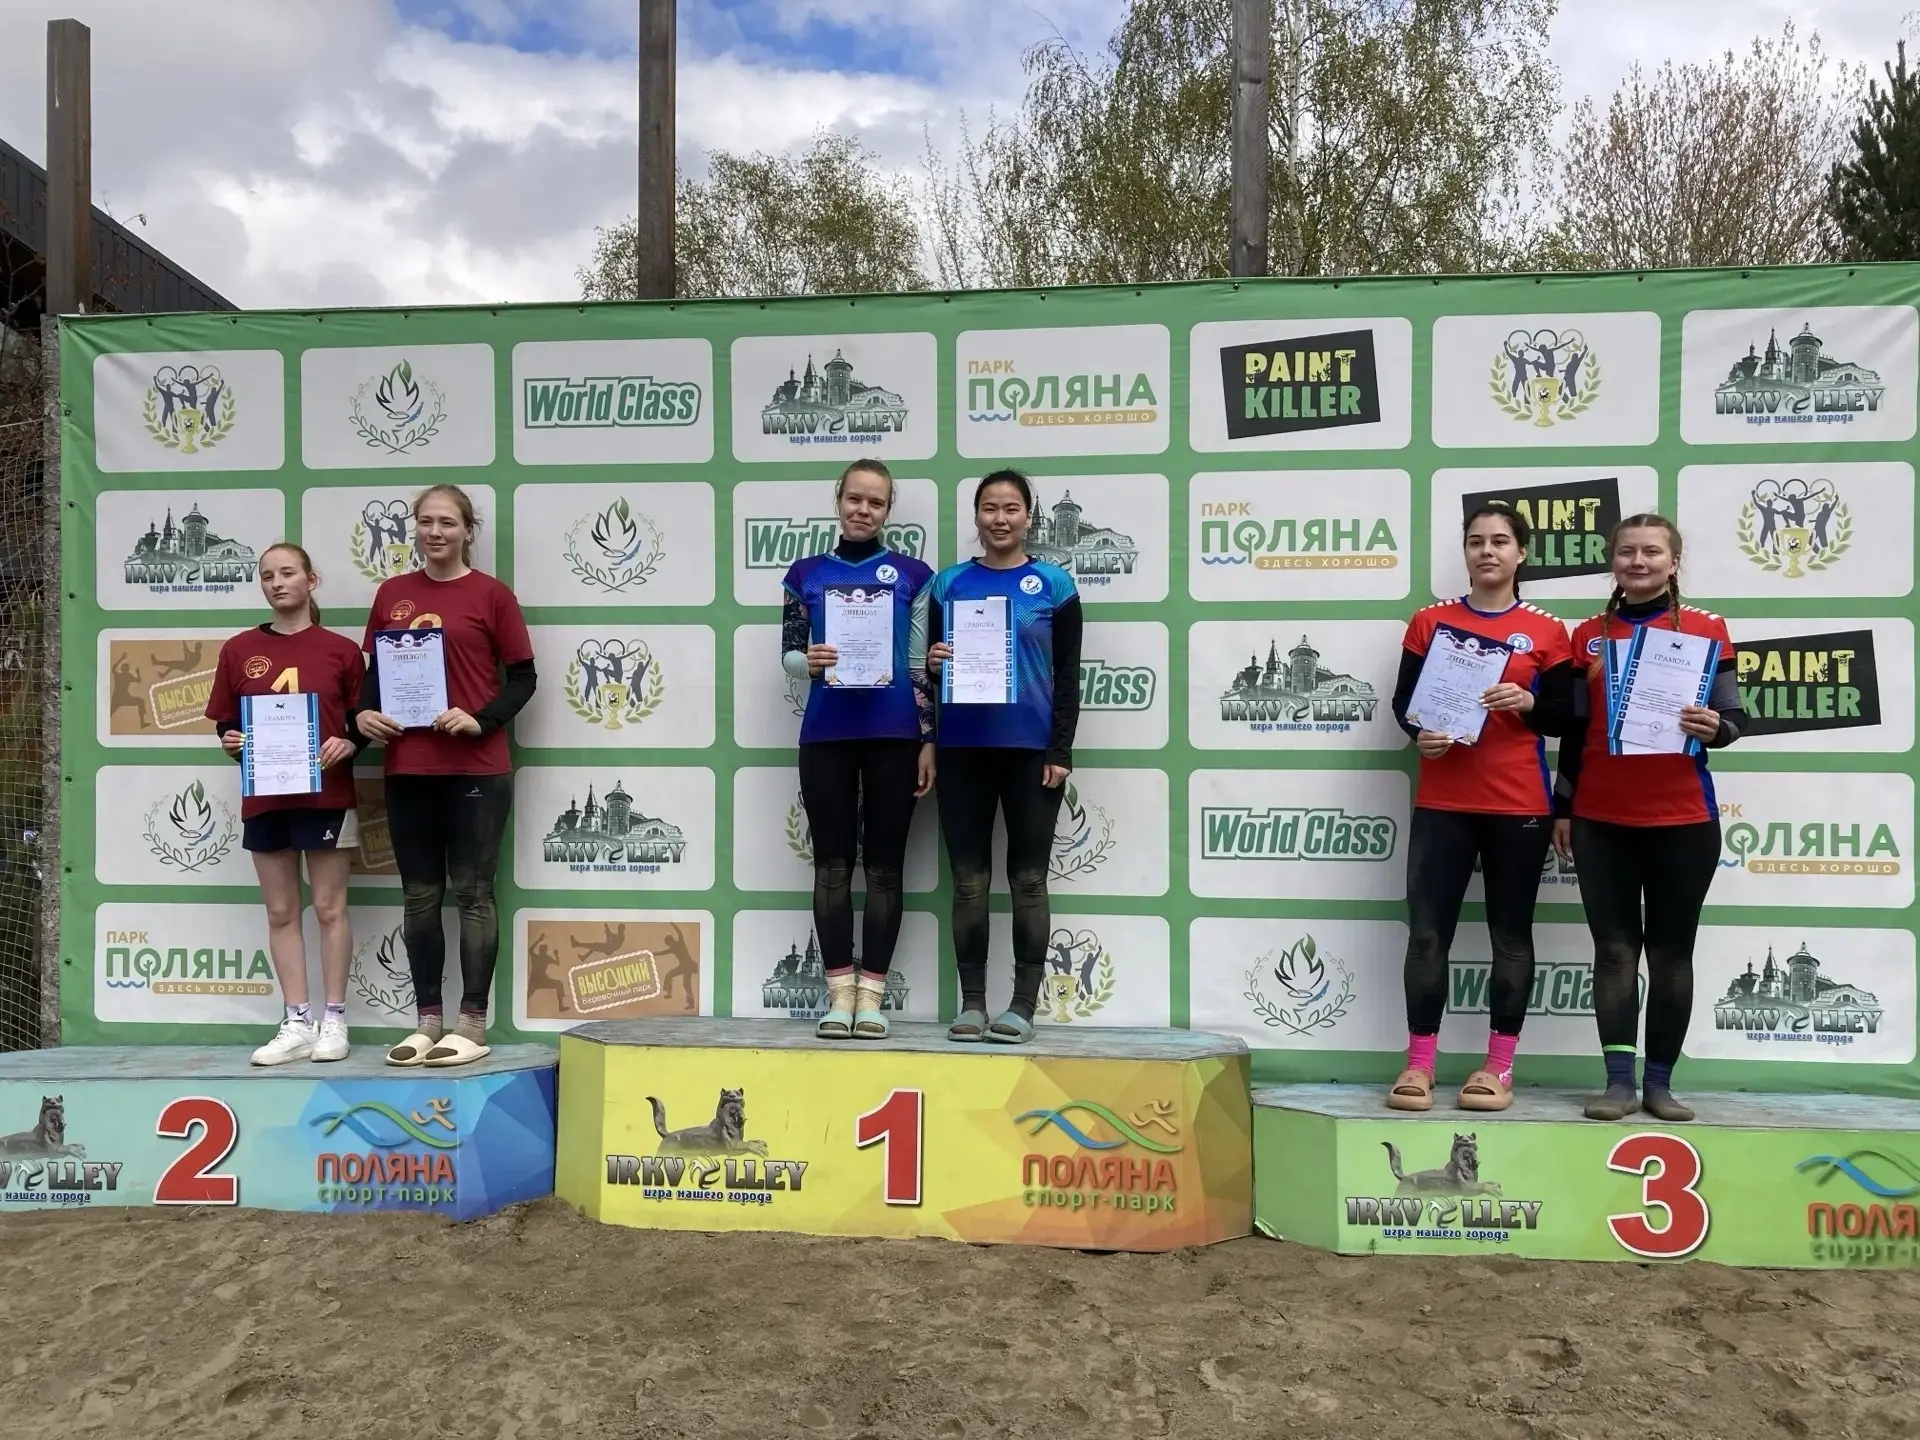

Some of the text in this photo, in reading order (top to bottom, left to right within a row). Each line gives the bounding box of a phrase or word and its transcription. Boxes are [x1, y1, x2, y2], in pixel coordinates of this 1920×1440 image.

[968, 360, 1015, 375] ПАРК
[1245, 349, 1356, 384] PAINT
[530, 382, 697, 422] World Class
[969, 373, 1157, 413] ПОЛЯНА
[1244, 385, 1361, 419] KILLER
[1026, 411, 1152, 424] ЗДЕСЬ ХОРОШО
[1746, 415, 1772, 426] игра
[1816, 413, 1854, 424] города
[789, 434, 882, 445] игра нашего города
[1201, 502, 1251, 517] ПАРК
[1488, 498, 1601, 531] AINT
[1201, 518, 1397, 554] ПОЛЯНА
[1527, 533, 1606, 566] LLER
[1262, 557, 1391, 569] ЗДЕСЬ ХОРОШО
[1446, 653, 1485, 672] ДИПЛОМ
[1654, 653, 1692, 667] ГРАМОТА
[1736, 650, 1855, 684] PAINT
[157, 680, 212, 712] ВЫСОЦК
[1738, 686, 1861, 719] KILLER
[1250, 722, 1351, 733] игра нашего города
[1719, 803, 1743, 818] РК
[1208, 813, 1390, 855] World Class
[1725, 822, 1901, 858] ОЛЯНА
[569, 863, 661, 874] игра нашего города
[1756, 863, 1892, 873] ЗДЕСЬ ХОРОШО
[105, 929, 149, 945] ПАРК
[106, 946, 274, 981] ПОЛЯНА
[577, 957, 650, 996] ВЫСОЦКИЙ
[157, 984, 268, 995] ЗДЕСЬ ХОРОШО
[581, 984, 653, 1005] Веревочный парк
[1551, 969, 1594, 1009] Cla
[1746, 1032, 1854, 1045] игра нашего города
[153, 1095, 239, 1206] 2
[855, 1087, 925, 1206] 1
[316, 1152, 455, 1185] ПОЛЯНА
[1021, 1153, 1177, 1192] ПОЛЯНА
[5, 1191, 91, 1205] нашего города
[317, 1183, 455, 1204] спорт-парк
[644, 1188, 772, 1204] игра нашего города
[1021, 1188, 1177, 1213] спорт-парк
[1606, 1131, 1710, 1259] 3
[1807, 1202, 1920, 1238] ПОЛЯ
[1383, 1228, 1509, 1242] игра нашего города
